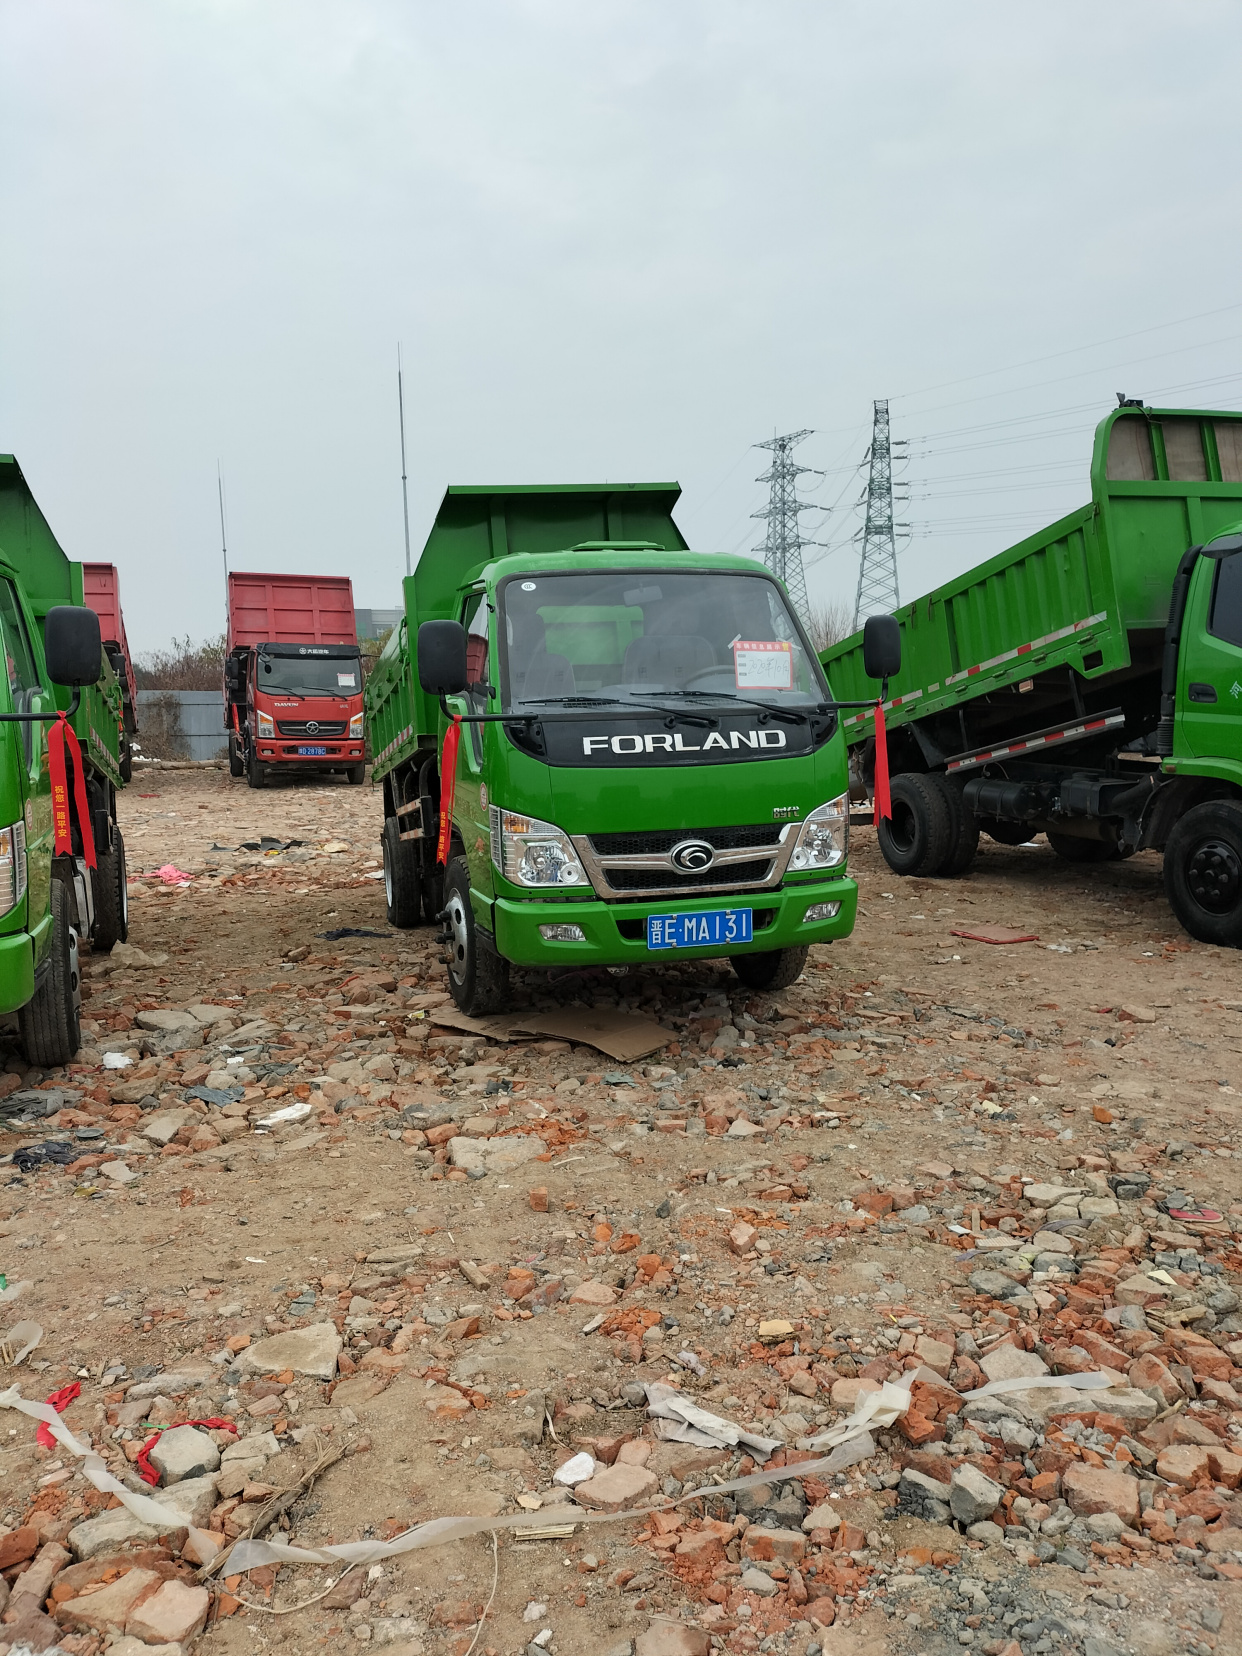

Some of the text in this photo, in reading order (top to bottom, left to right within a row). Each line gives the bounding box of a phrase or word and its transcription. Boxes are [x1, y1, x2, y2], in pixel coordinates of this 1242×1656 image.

[582, 729, 787, 755] FORLAND
[54, 785, 68, 838] 祝您一路平安
